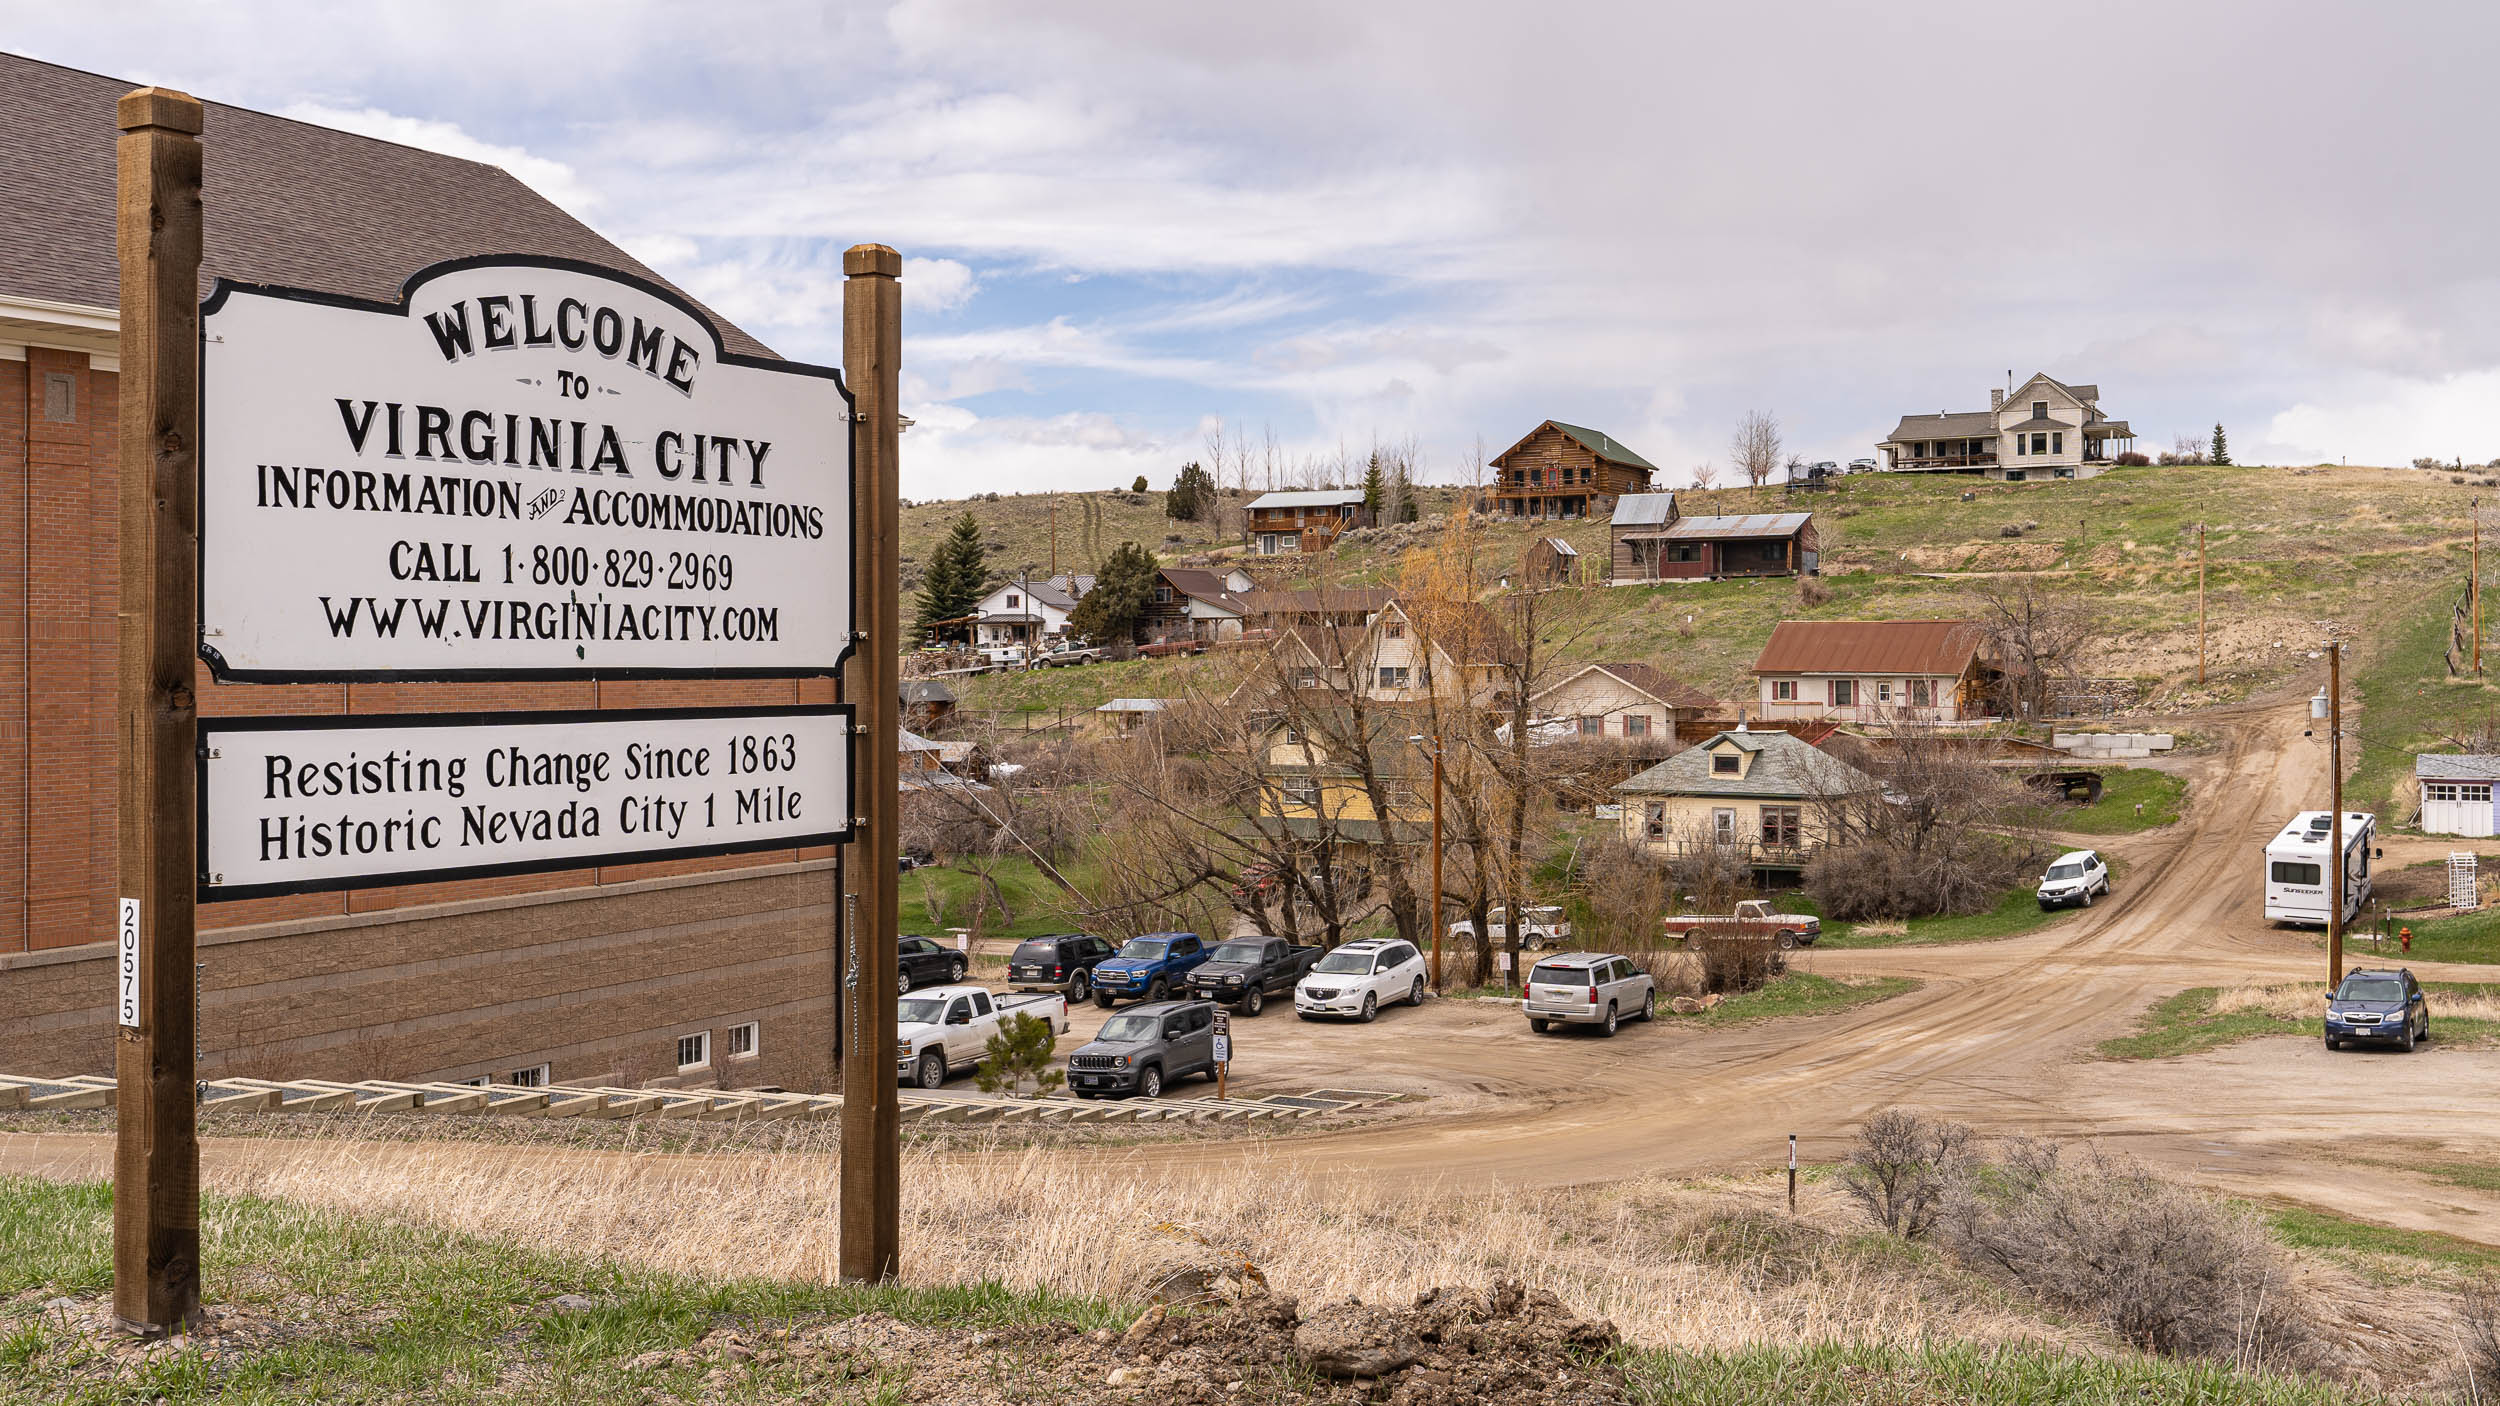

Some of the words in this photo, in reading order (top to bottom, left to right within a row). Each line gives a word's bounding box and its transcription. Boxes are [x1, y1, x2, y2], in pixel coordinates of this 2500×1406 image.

[422, 294, 700, 398] WELCOME
[557, 369, 590, 400] TO
[334, 398, 633, 476] VIRGINIA
[655, 430, 772, 487] CITY
[257, 464, 523, 520] INFORMATION
[527, 487, 566, 521] AND
[562, 486, 824, 540] ACCOMMODATIONS
[389, 540, 481, 583] CALL
[318, 596, 779, 643] WWW.VIRGINIACITY.COM
[263, 749, 467, 799] Resisting
[486, 746, 610, 793] Change
[624, 742, 711, 782] Since
[727, 733, 798, 775] 1863
[259, 810, 442, 862] Historic
[459, 800, 601, 848] Nevada
[619, 795, 688, 840] City
[704, 791, 715, 828] 1
[734, 785, 803, 825] Mile
[123, 905, 135, 1020] 20575
